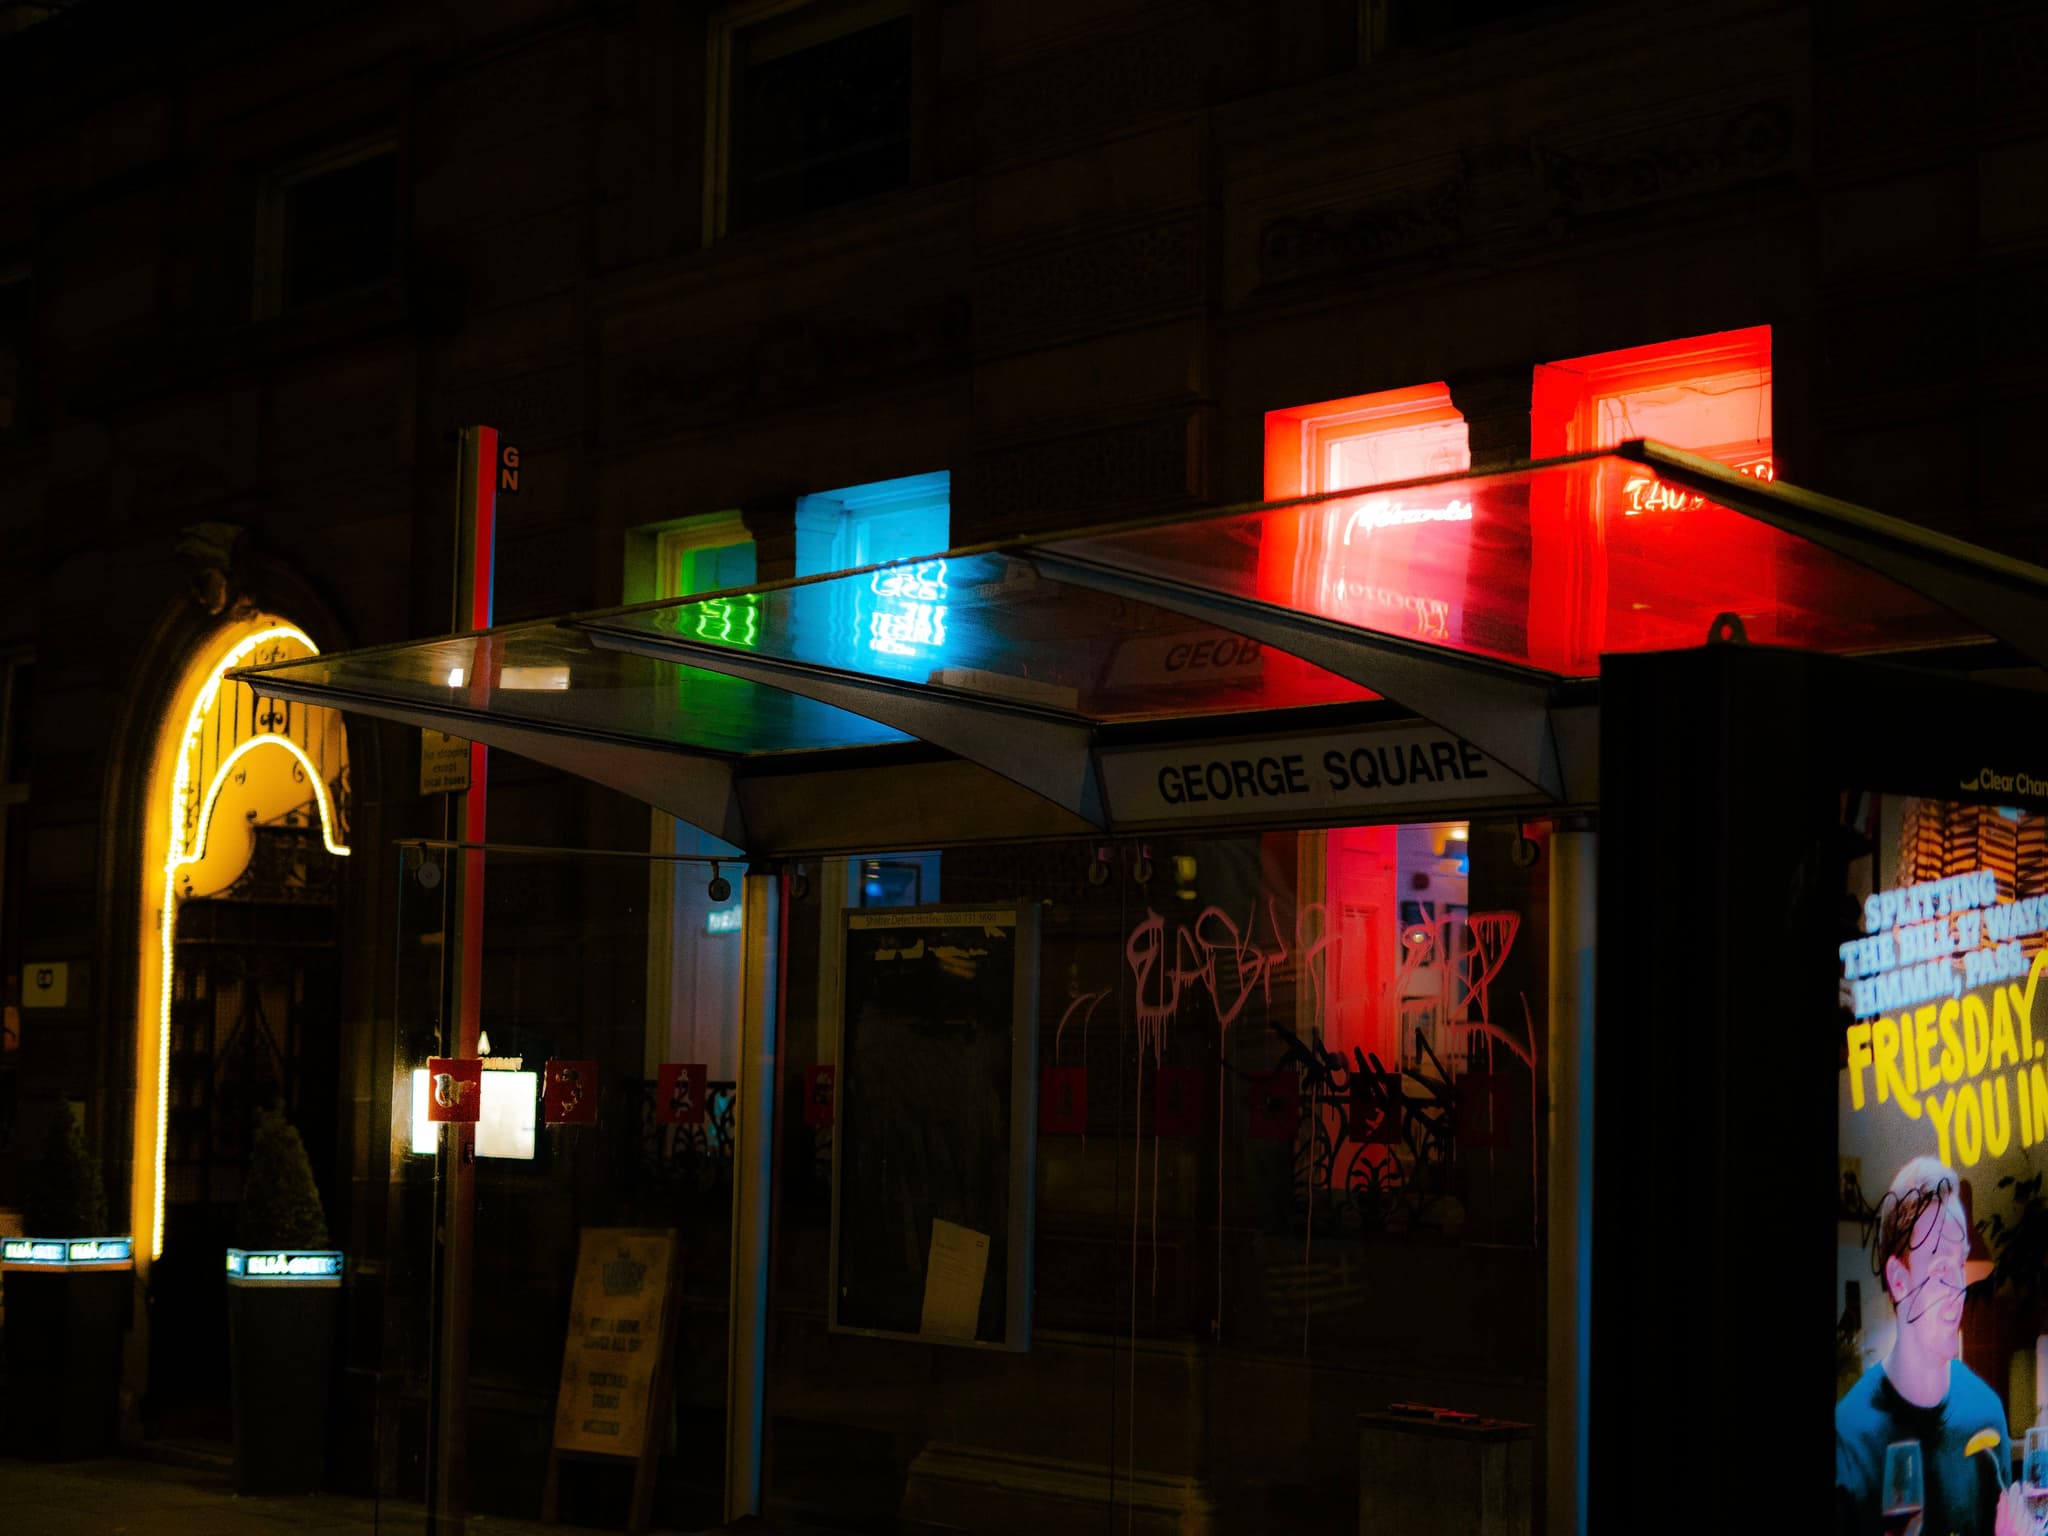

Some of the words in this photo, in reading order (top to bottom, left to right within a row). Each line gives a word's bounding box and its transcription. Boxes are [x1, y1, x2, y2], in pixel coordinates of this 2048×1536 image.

[1158, 755, 1309, 804] GEORGE
[1323, 740, 1487, 790] SQUARE
[1979, 767, 2014, 793] Clear
[1839, 931, 1895, 980] THE
[1900, 919, 1954, 965] BILL
[1957, 908, 1981, 947] 17
[1984, 894, 2048, 942] WAYS
[1865, 869, 1996, 933] SPLITTING
[1854, 959, 1962, 1018] HMMM,
[1964, 941, 2030, 989] PASS.
[1847, 950, 2048, 1119] FRIESDAY.
[1926, 1074, 2011, 1168] YOU
